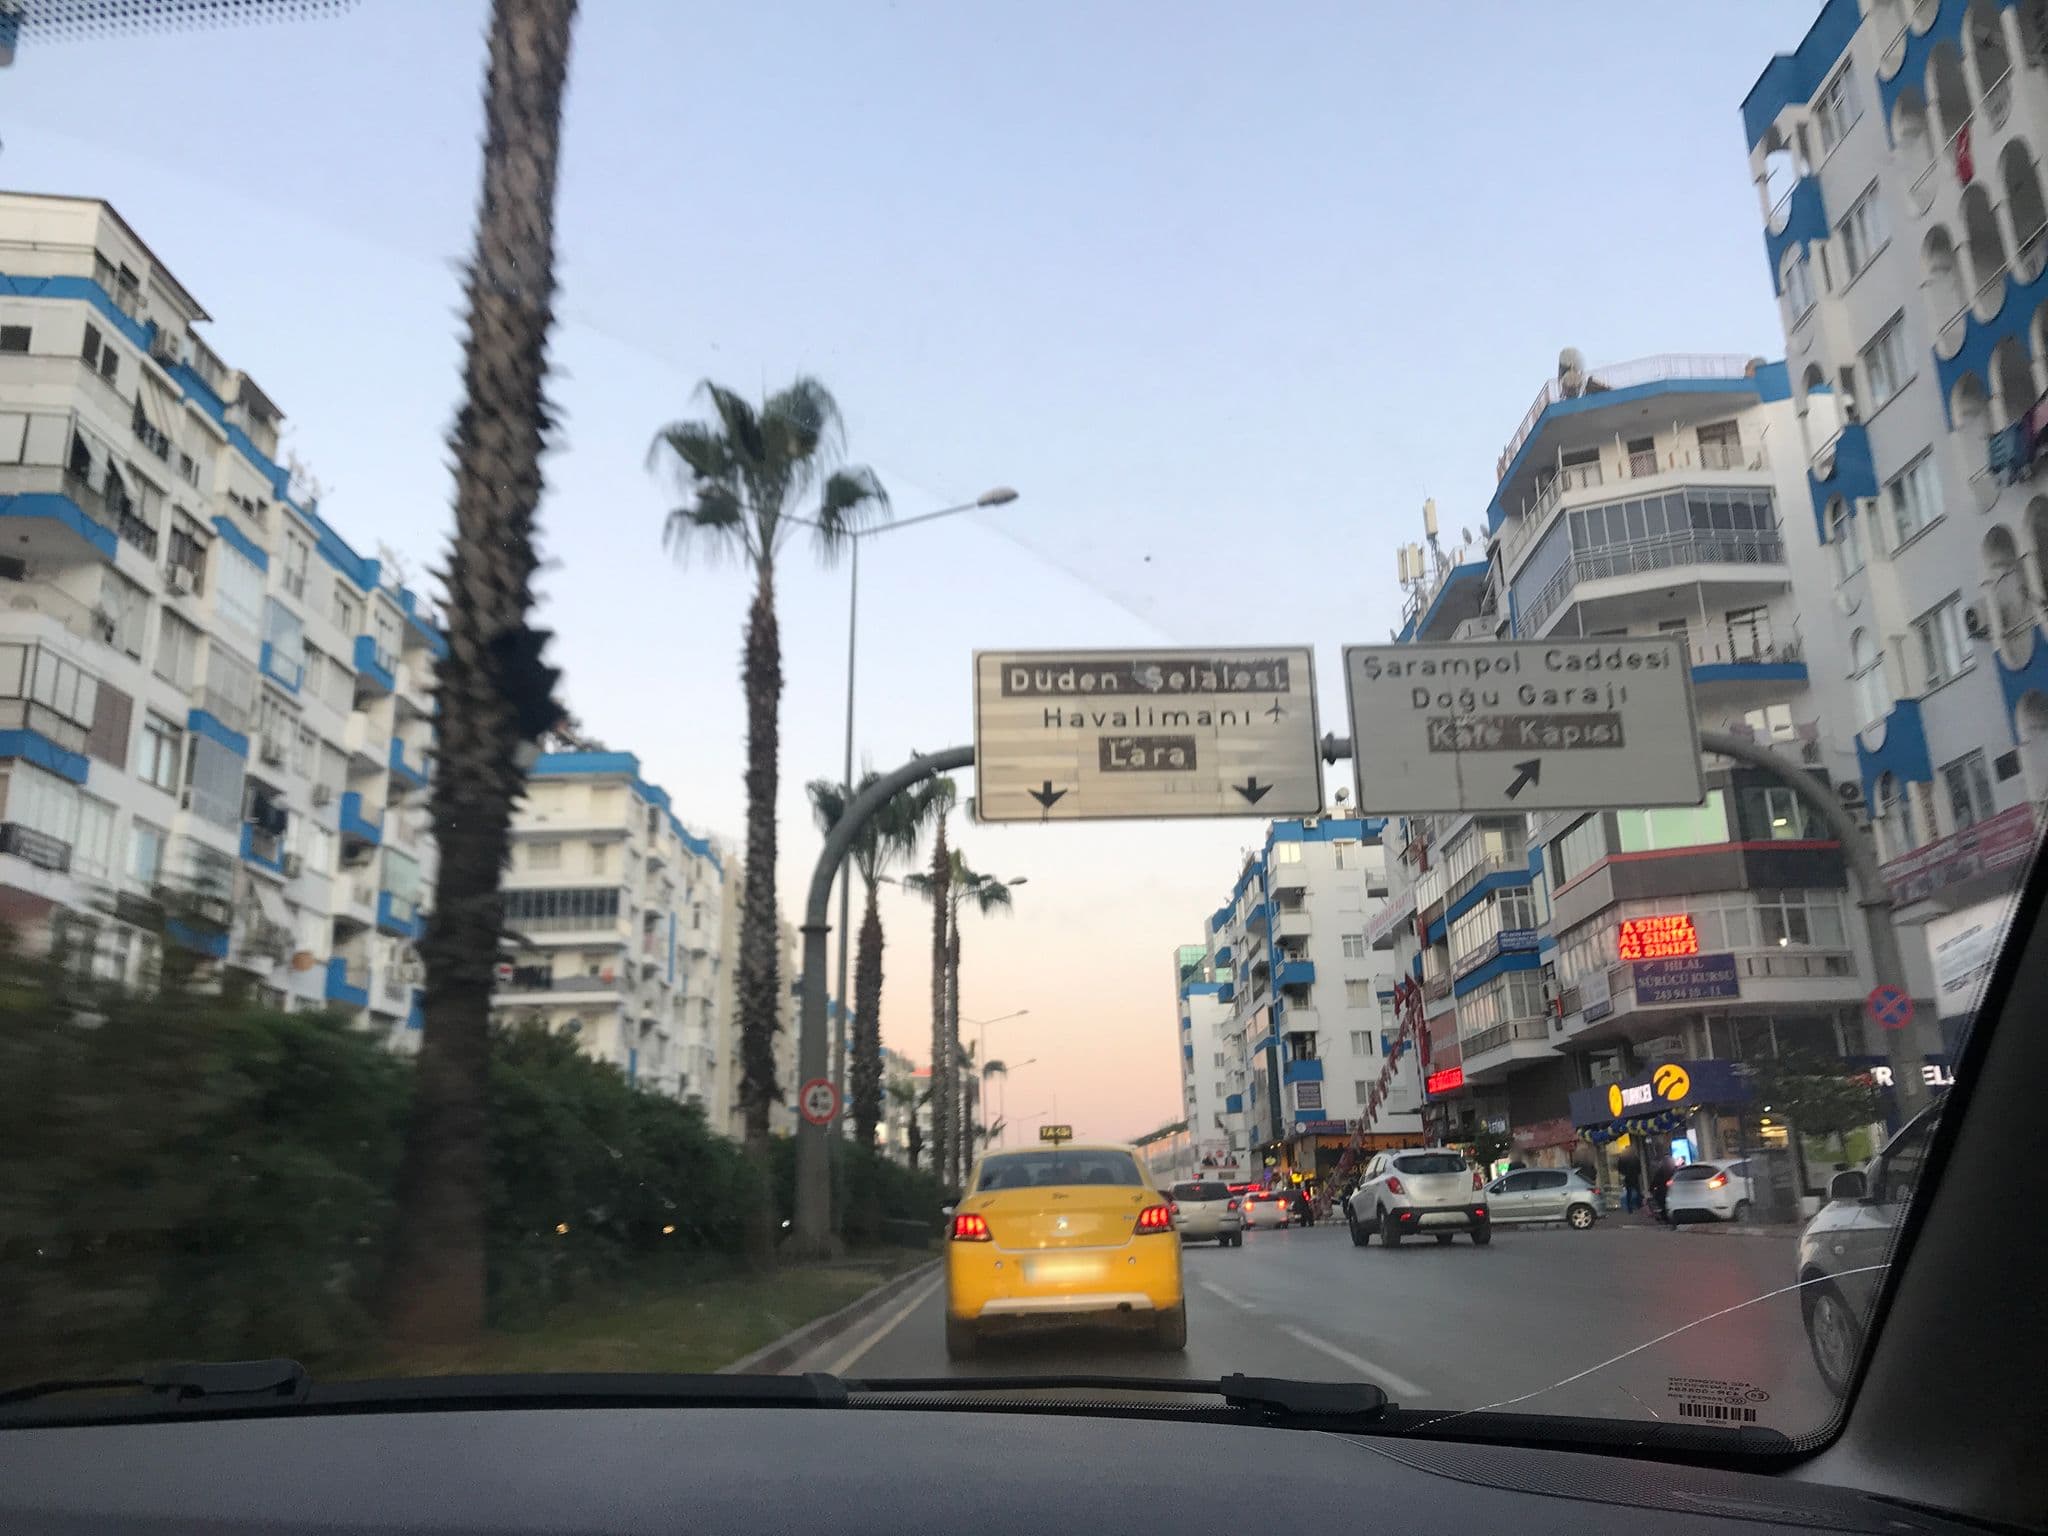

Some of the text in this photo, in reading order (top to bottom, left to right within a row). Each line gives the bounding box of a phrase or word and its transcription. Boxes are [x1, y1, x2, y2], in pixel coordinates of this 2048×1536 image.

[1363, 647, 1670, 680] Şarampol Caddesi
[1411, 681, 1627, 712] Doğu Garajı
[1044, 705, 1250, 728] Havalimanı
[1110, 742, 1185, 768] Lara
[1622, 921, 1634, 934] A
[1620, 934, 1641, 946] A1
[1620, 946, 1642, 959] A2
